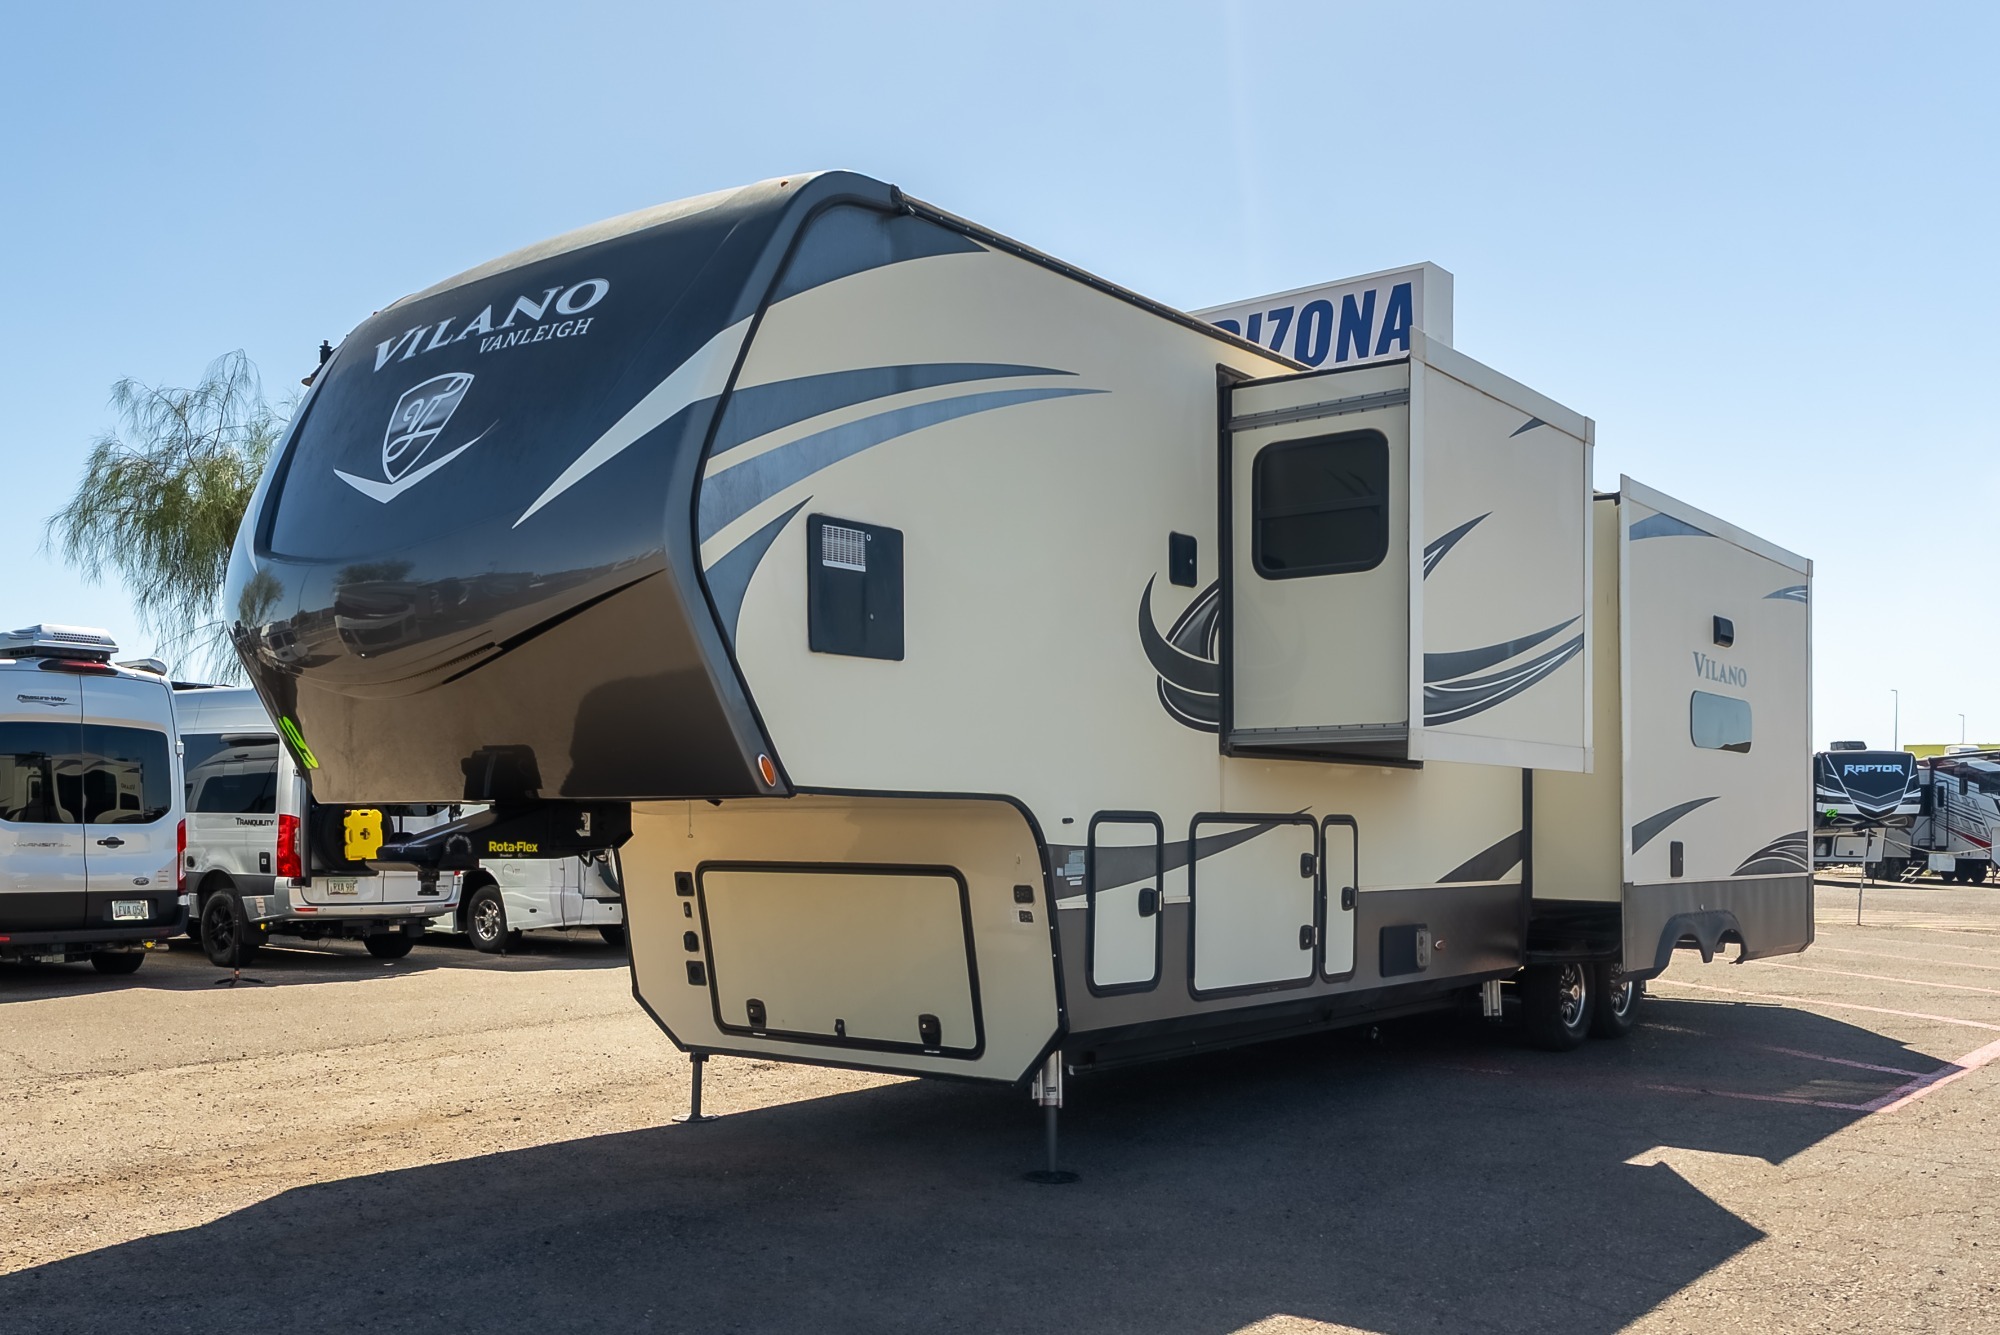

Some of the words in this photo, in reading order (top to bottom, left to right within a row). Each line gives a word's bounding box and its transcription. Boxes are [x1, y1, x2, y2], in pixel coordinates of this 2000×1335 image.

[373, 278, 610, 373] VILANO
[479, 317, 595, 354] VANLEIGH
[1692, 651, 1747, 688] VILANO
[17, 694, 68, 702] Pleasure-Way
[1843, 764, 1905, 777] RAPTOR
[1826, 809, 1838, 818] 22
[235, 817, 275, 827] TRANQUILITY
